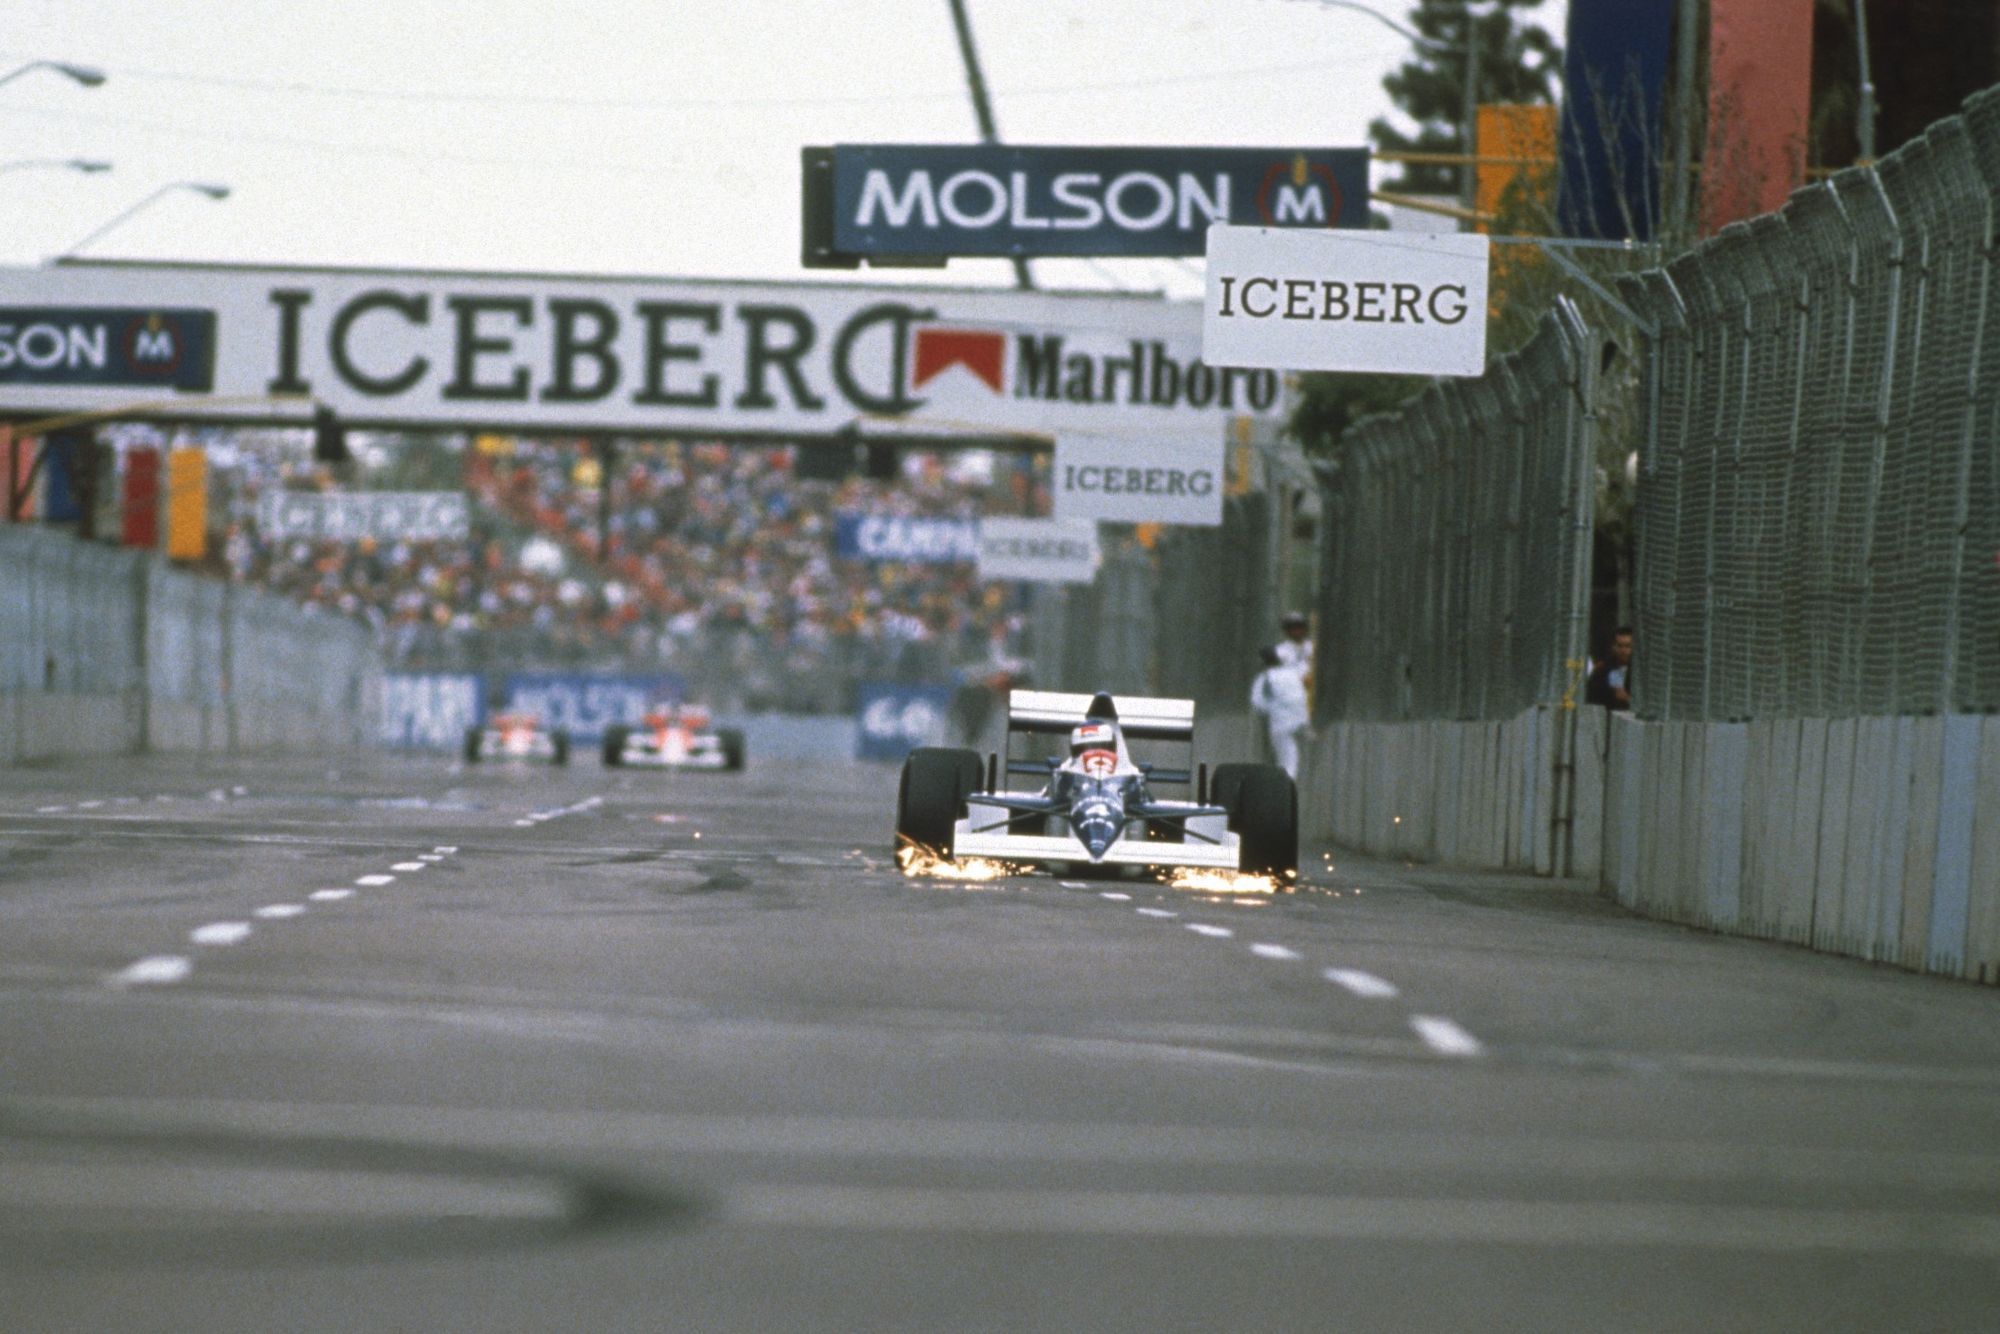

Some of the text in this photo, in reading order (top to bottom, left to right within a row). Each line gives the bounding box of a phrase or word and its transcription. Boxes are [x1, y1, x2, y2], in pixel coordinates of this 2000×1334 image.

[855, 169, 1231, 230] MOLSON
[1218, 276, 1469, 325] ICEBERG
[1014, 333, 1280, 411] Marlboro
[1065, 464, 1214, 497] ICEBERG
